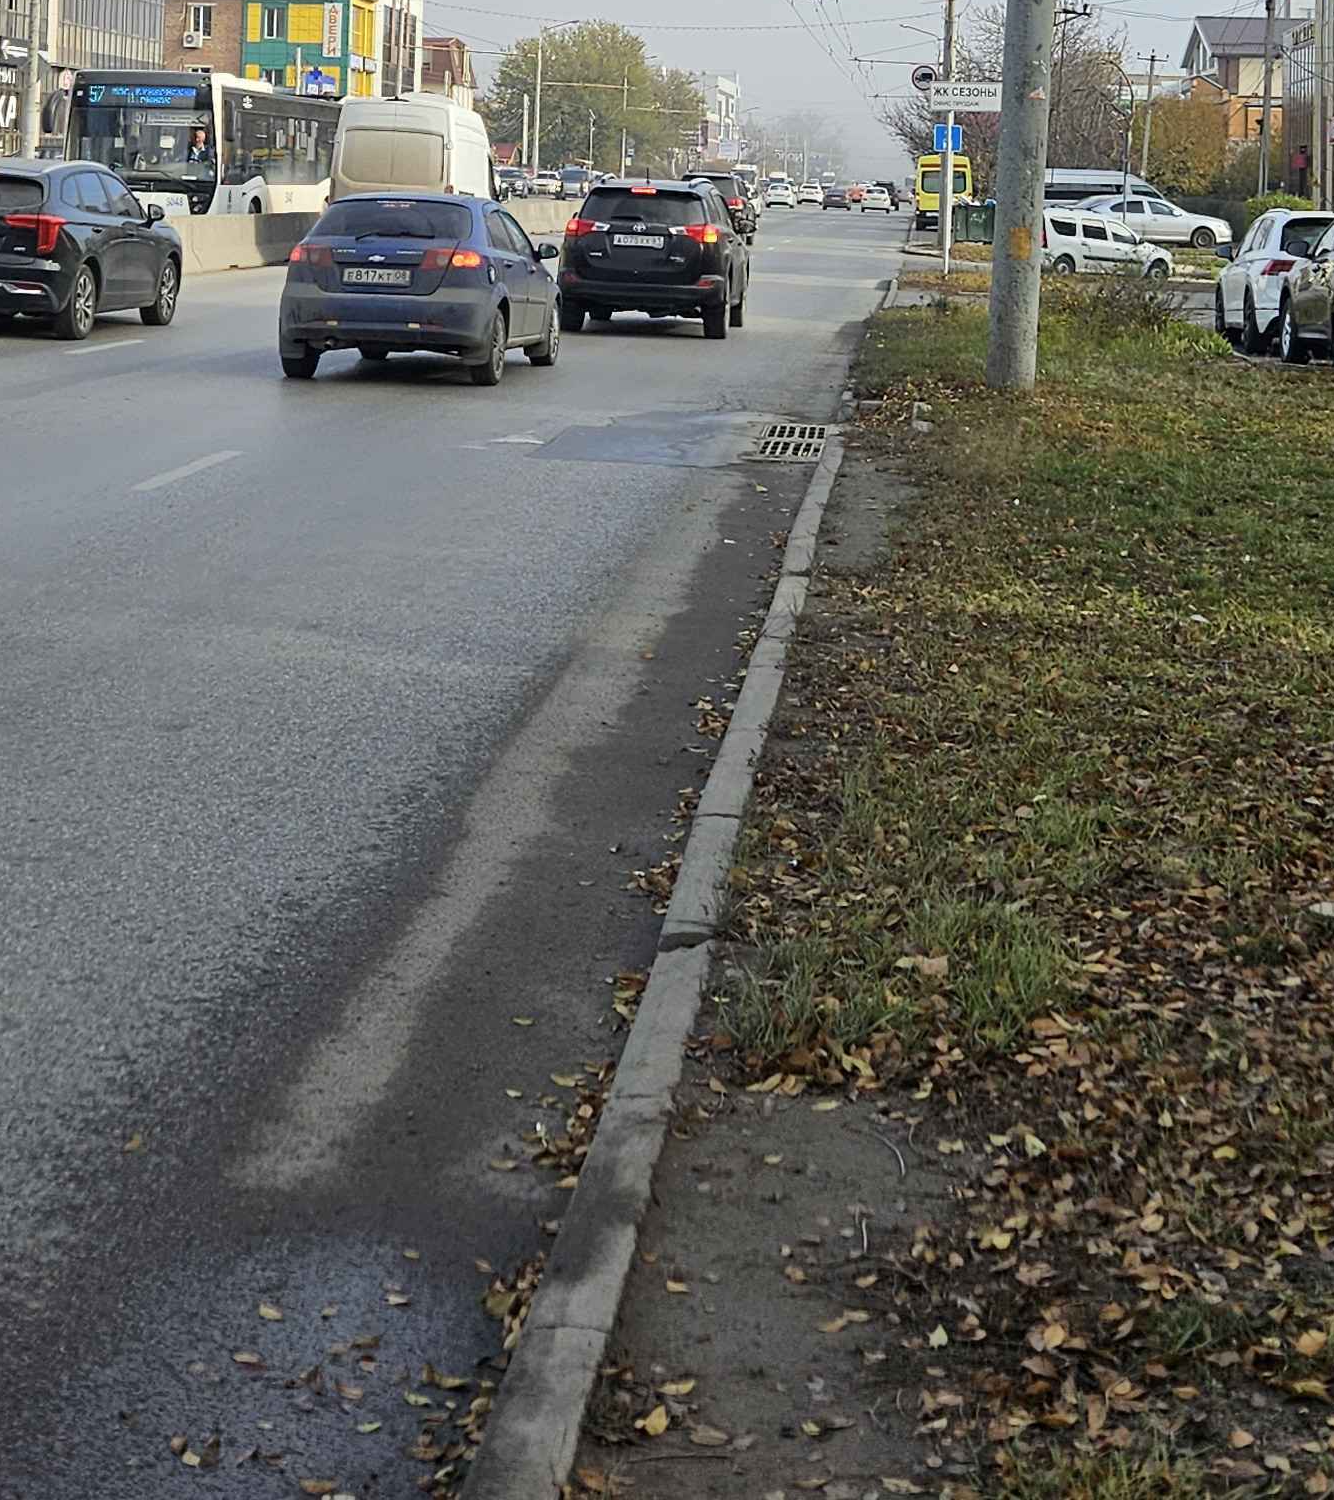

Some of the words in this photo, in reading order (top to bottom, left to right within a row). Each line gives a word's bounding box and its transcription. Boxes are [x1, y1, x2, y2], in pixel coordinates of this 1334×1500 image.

[89, 85, 105, 104] 57
[934, 87, 949, 97] ЖК
[952, 87, 997, 97] СЕЗОНЫ
